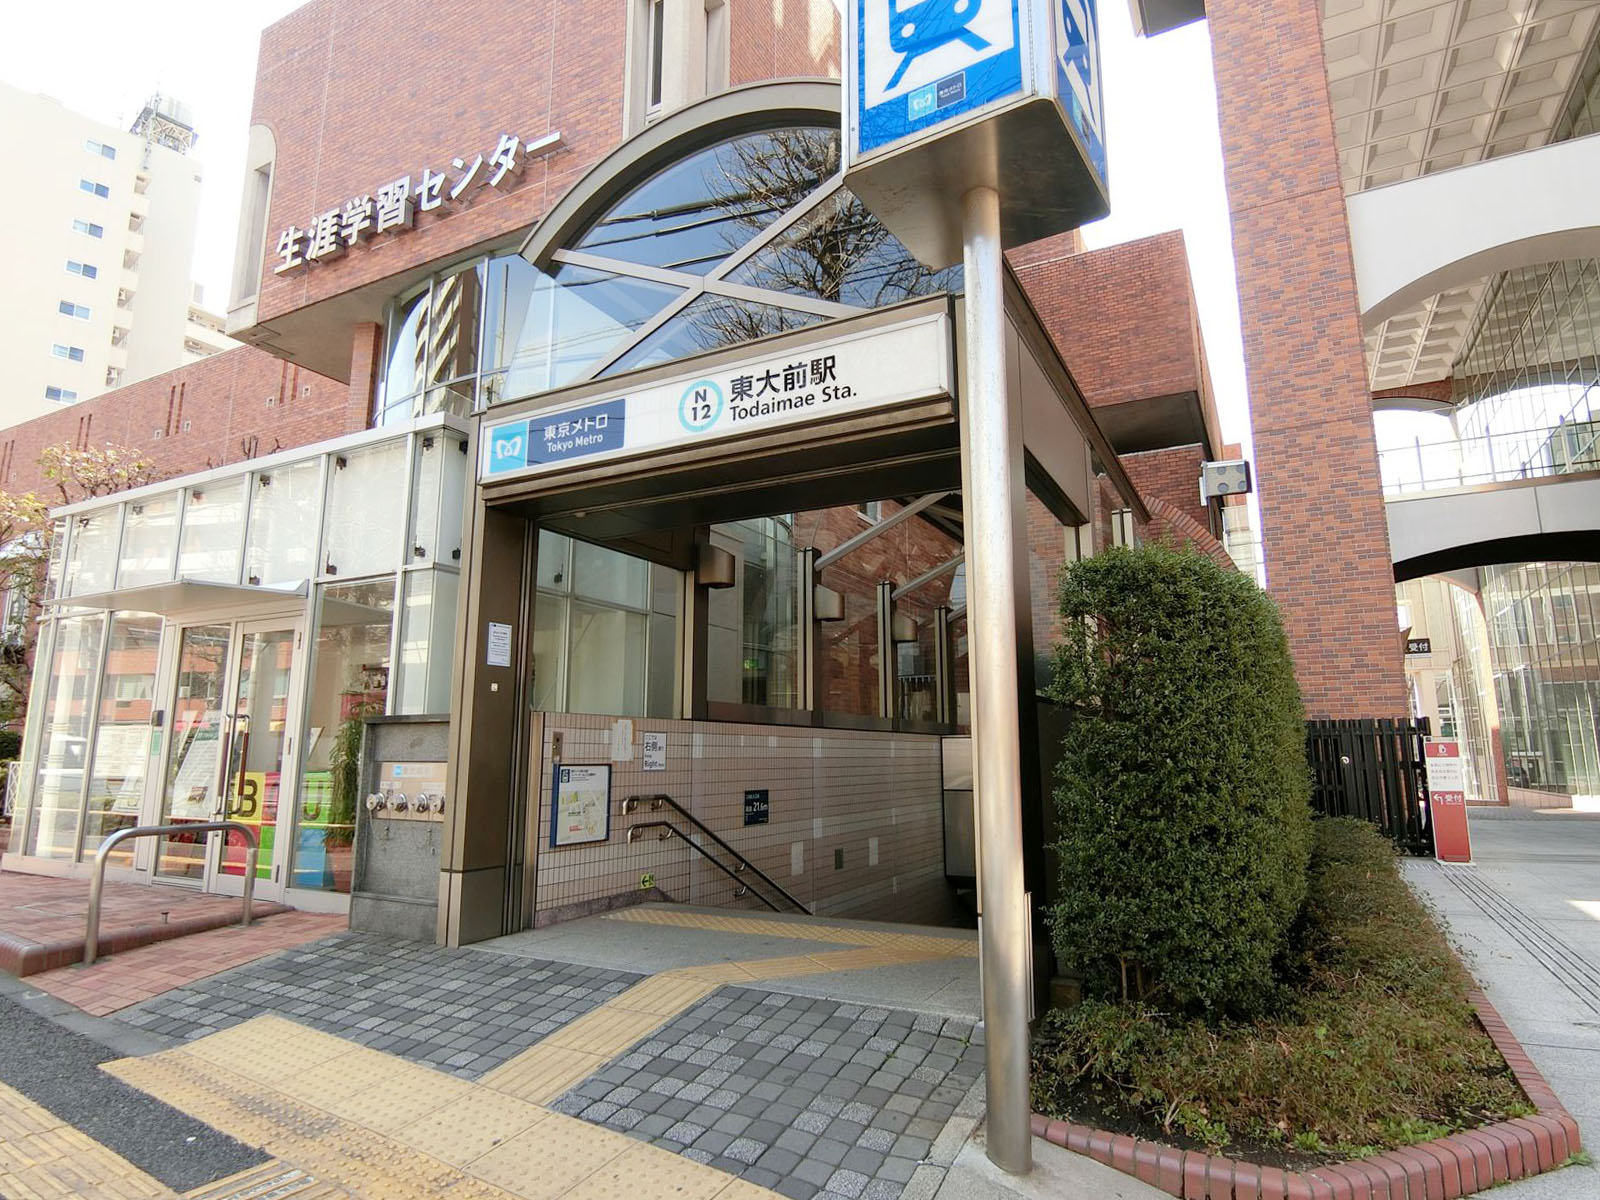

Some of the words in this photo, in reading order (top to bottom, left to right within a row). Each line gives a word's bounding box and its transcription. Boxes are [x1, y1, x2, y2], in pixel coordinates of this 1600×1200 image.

[274, 131, 561, 274] 生涯学習センター
[730, 355, 836, 402] 東大前駅
[694, 388, 707, 404] N
[730, 393, 815, 421] Todaimae
[822, 384, 857, 403] Sta.
[691, 404, 711, 421] 12
[543, 413, 608, 441] 東京メトロ
[547, 439, 574, 453] Tokyo
[575, 434, 604, 447] Metro
[1408, 642, 1429, 652] 受付
